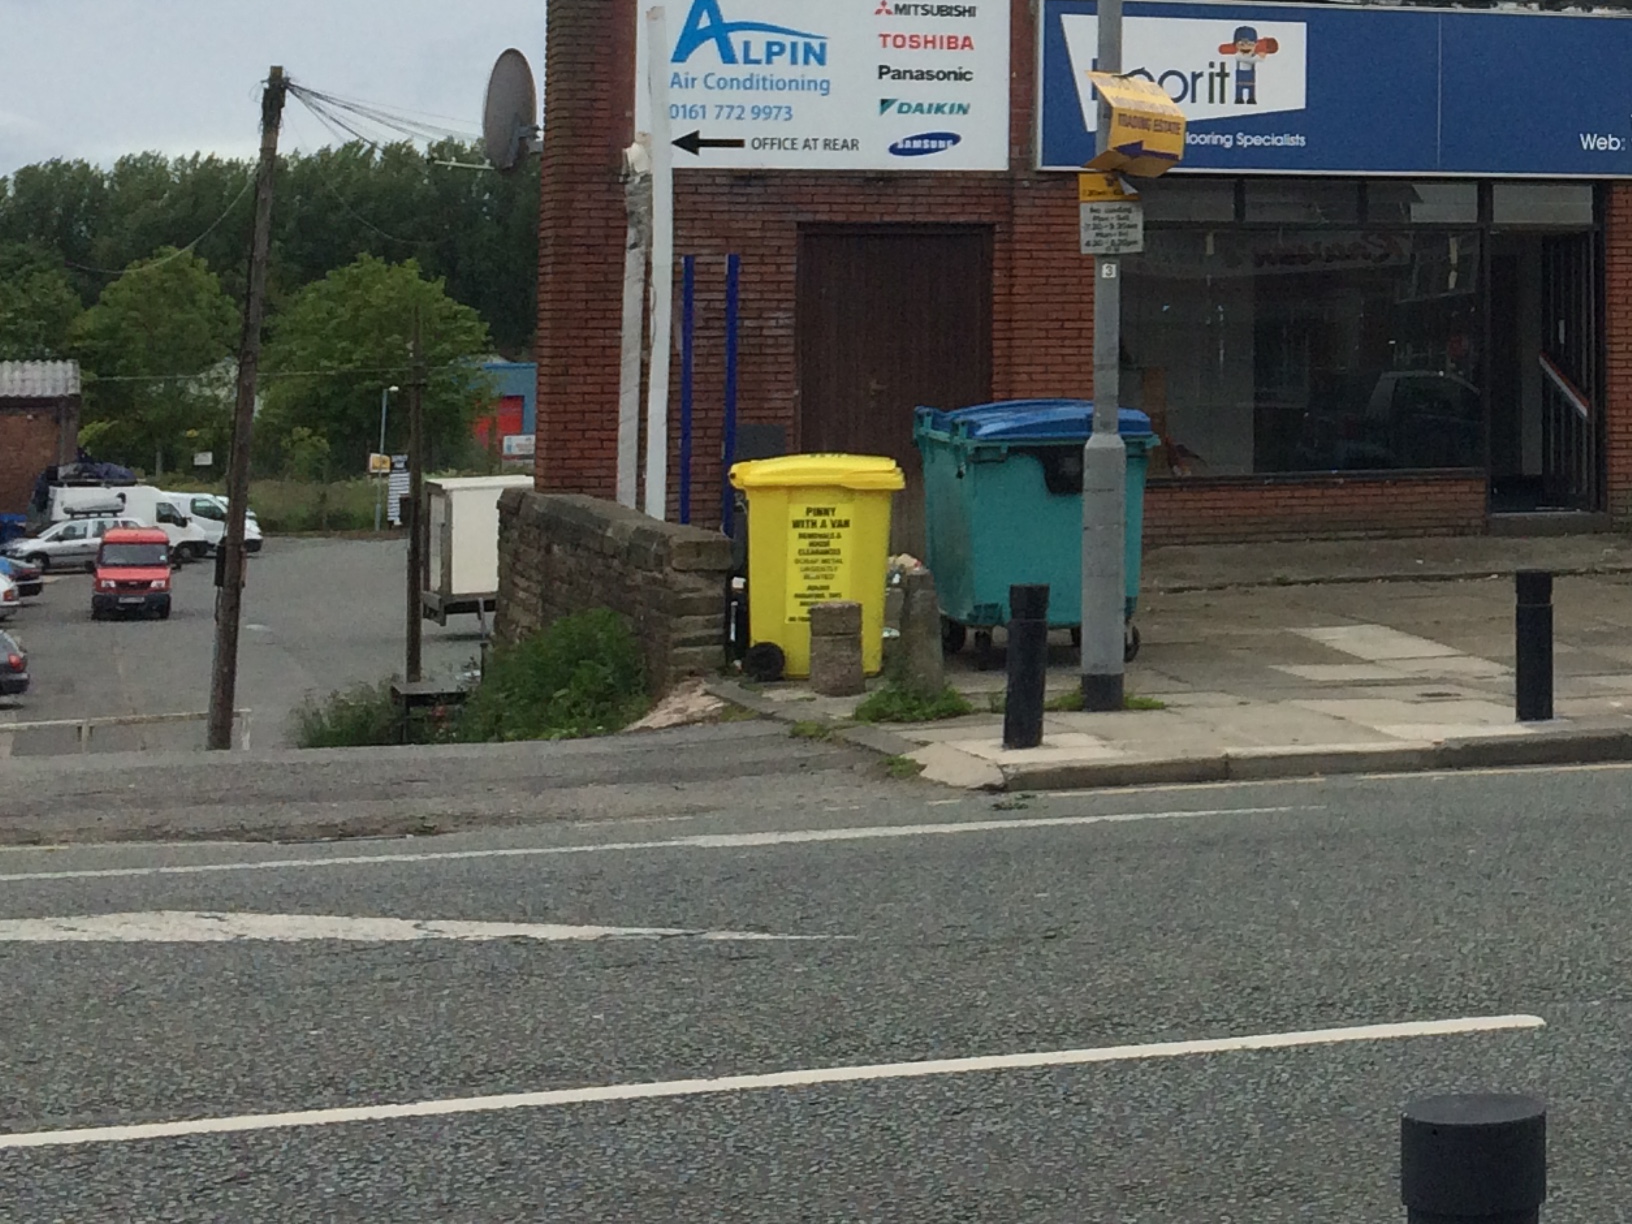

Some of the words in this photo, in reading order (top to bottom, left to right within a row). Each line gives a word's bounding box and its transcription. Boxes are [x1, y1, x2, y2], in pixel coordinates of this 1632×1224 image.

[894, 3, 976, 18] MITSUBISHI
[878, 33, 974, 50] TOSHIBA
[878, 65, 973, 82] Panasonic
[670, 72, 698, 89] Air
[703, 72, 830, 96] Conditioning
[669, 104, 707, 121] 0161
[715, 105, 745, 121] 772
[750, 106, 793, 122] 9973
[897, 102, 971, 115] DAIKIN
[751, 137, 799, 151] OFFICE
[802, 137, 818, 151] AT
[823, 137, 860, 152] REAR
[1186, 132, 1233, 148] looring
[1236, 132, 1306, 148] Specialists
[1579, 133, 1626, 152] Web:
[1105, 264, 1114, 276] 3
[792, 519, 818, 528] WITH
[830, 519, 851, 528] VAN
